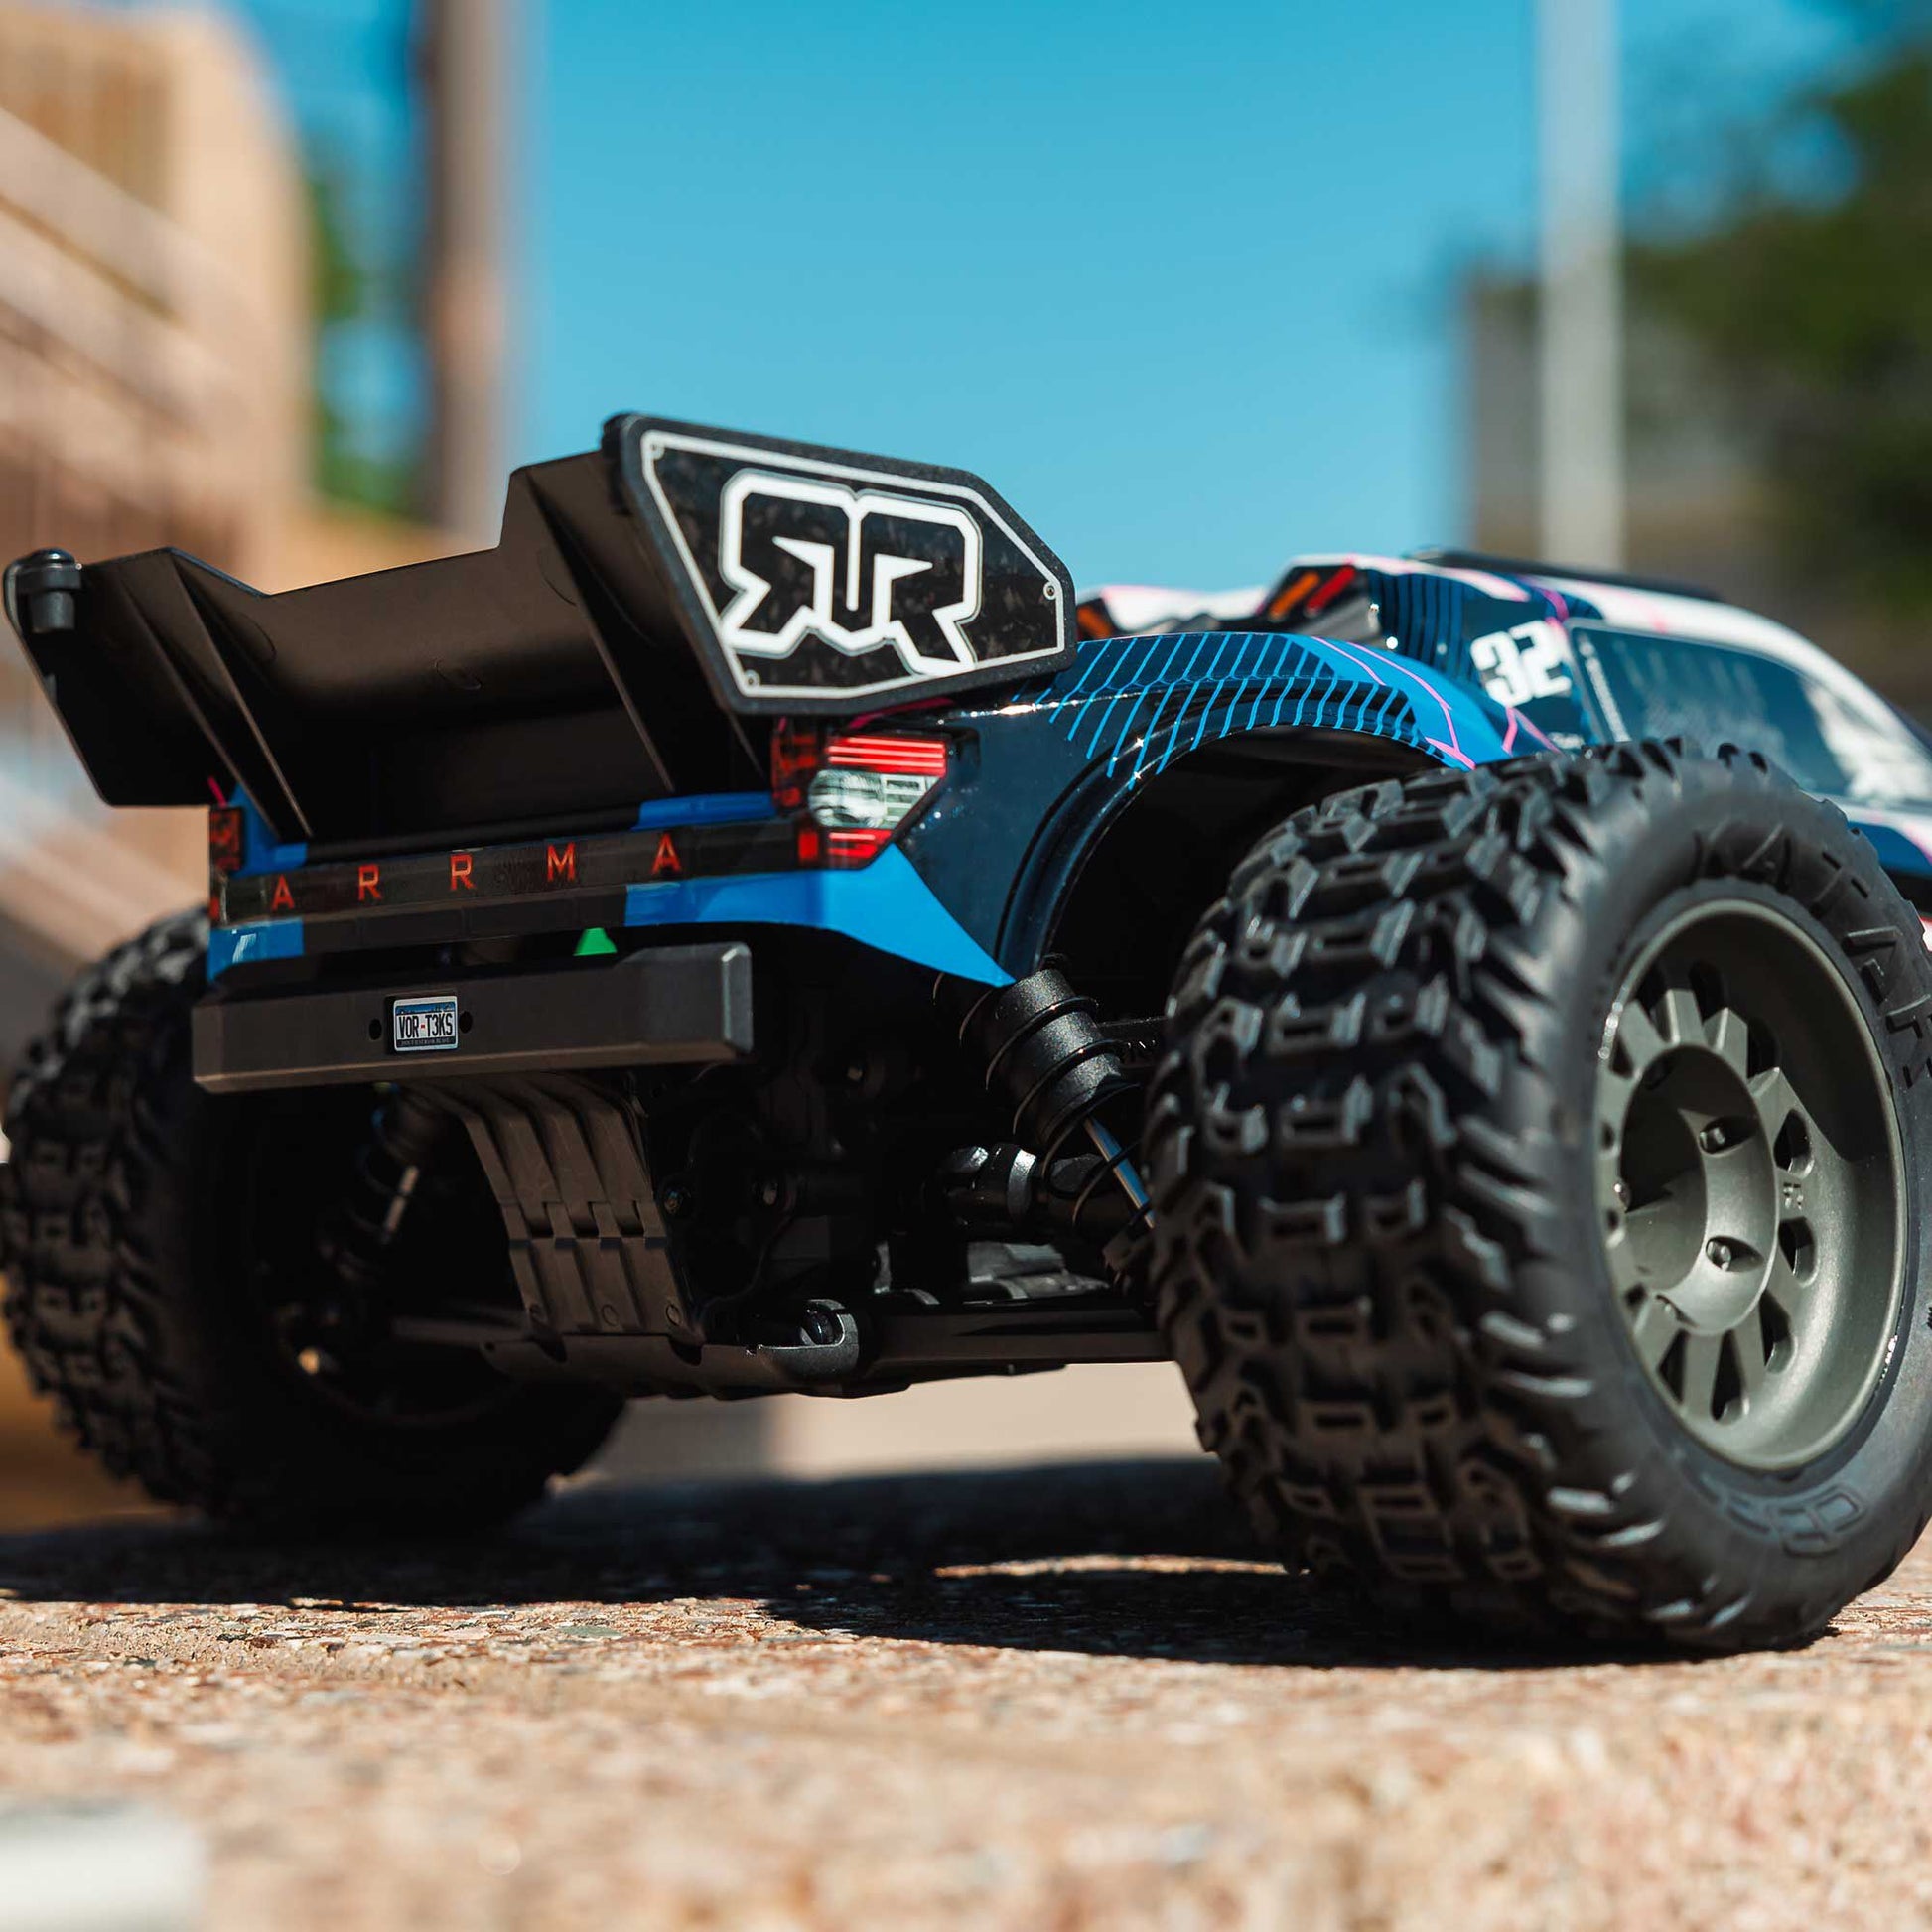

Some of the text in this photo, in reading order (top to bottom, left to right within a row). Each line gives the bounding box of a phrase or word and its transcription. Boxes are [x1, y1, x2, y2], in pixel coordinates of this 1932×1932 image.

[1470, 620, 1572, 708] 32
[272, 833, 681, 910] ARRMA
[398, 1012, 453, 1038] VOR-T3KS
